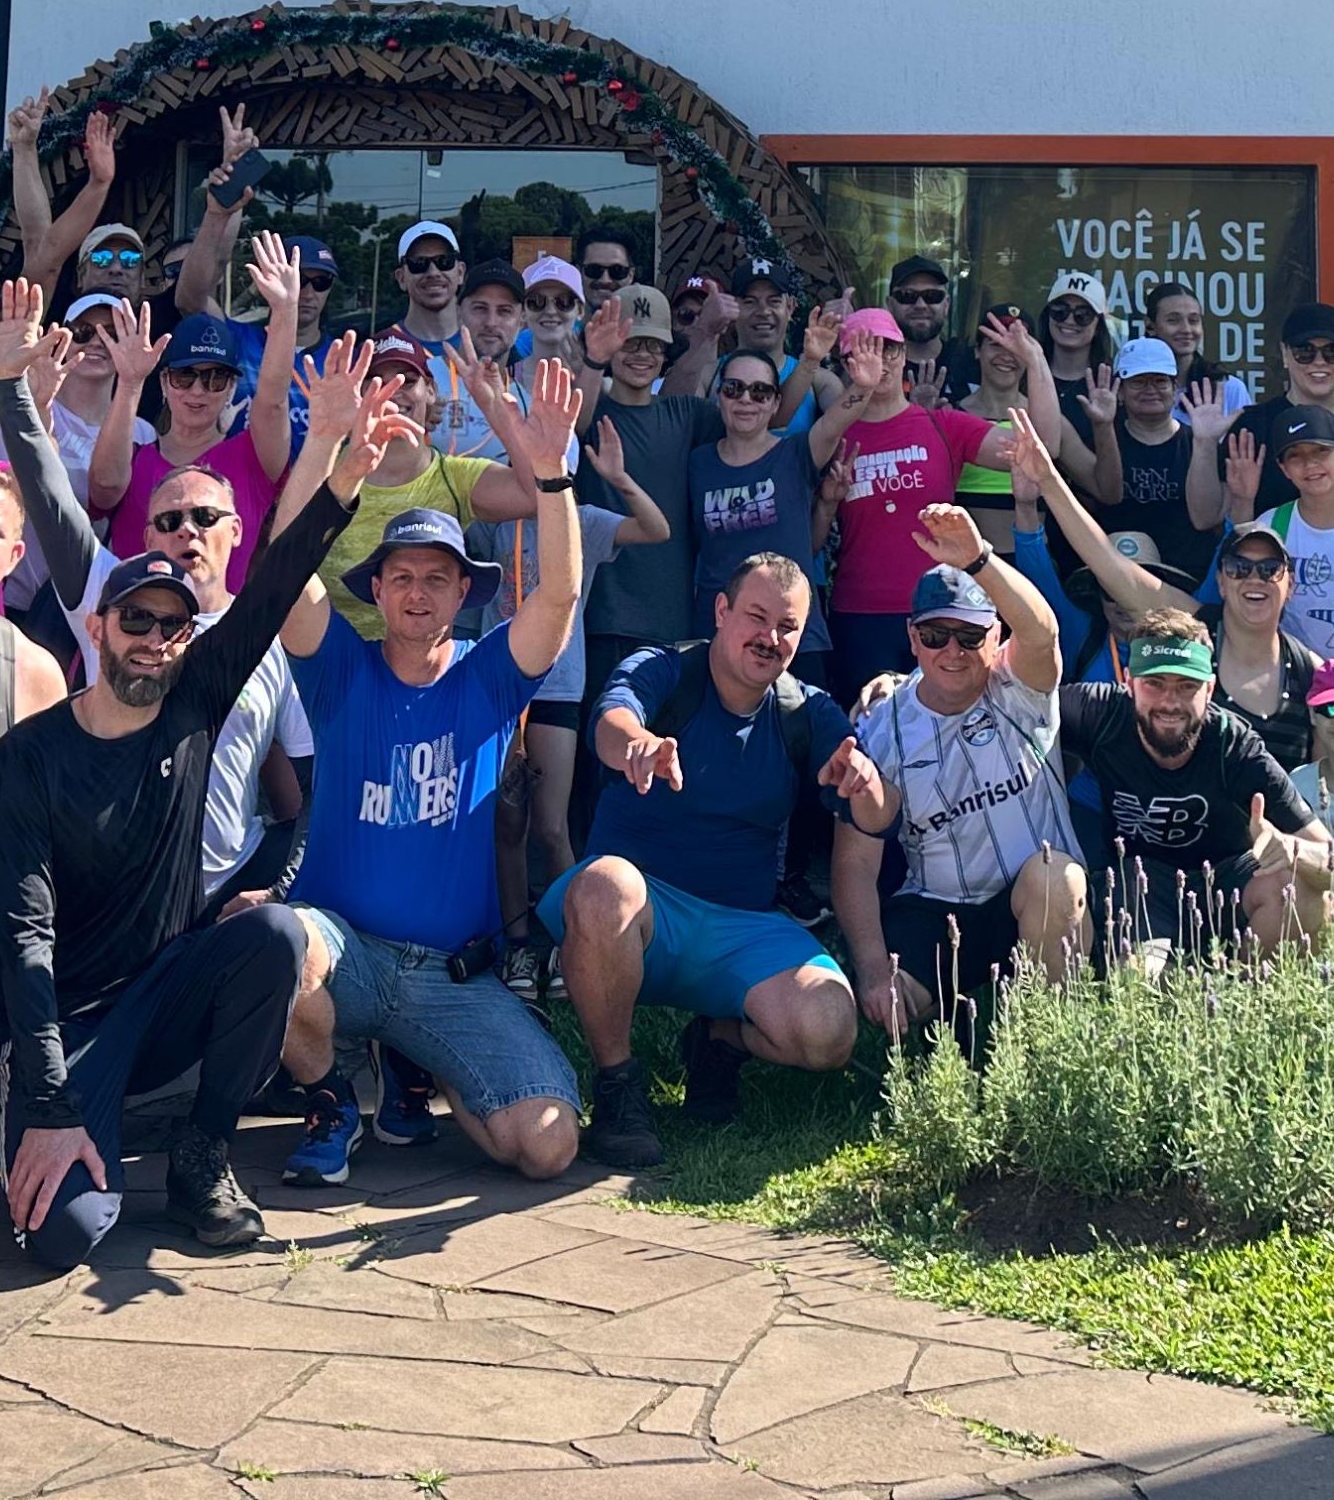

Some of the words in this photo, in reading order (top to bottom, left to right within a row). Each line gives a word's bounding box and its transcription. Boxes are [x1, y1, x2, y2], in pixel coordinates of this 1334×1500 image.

[1056, 207, 1154, 260] VOCÊ
[1167, 208, 1207, 261] JÁ
[1219, 220, 1266, 262] SE
[1068, 277, 1090, 292] NY
[633, 296, 652, 319] NY
[1219, 321, 1266, 363] DE
[876, 469, 926, 493] VOCÊ
[927, 761, 1030, 833] Banrisul
